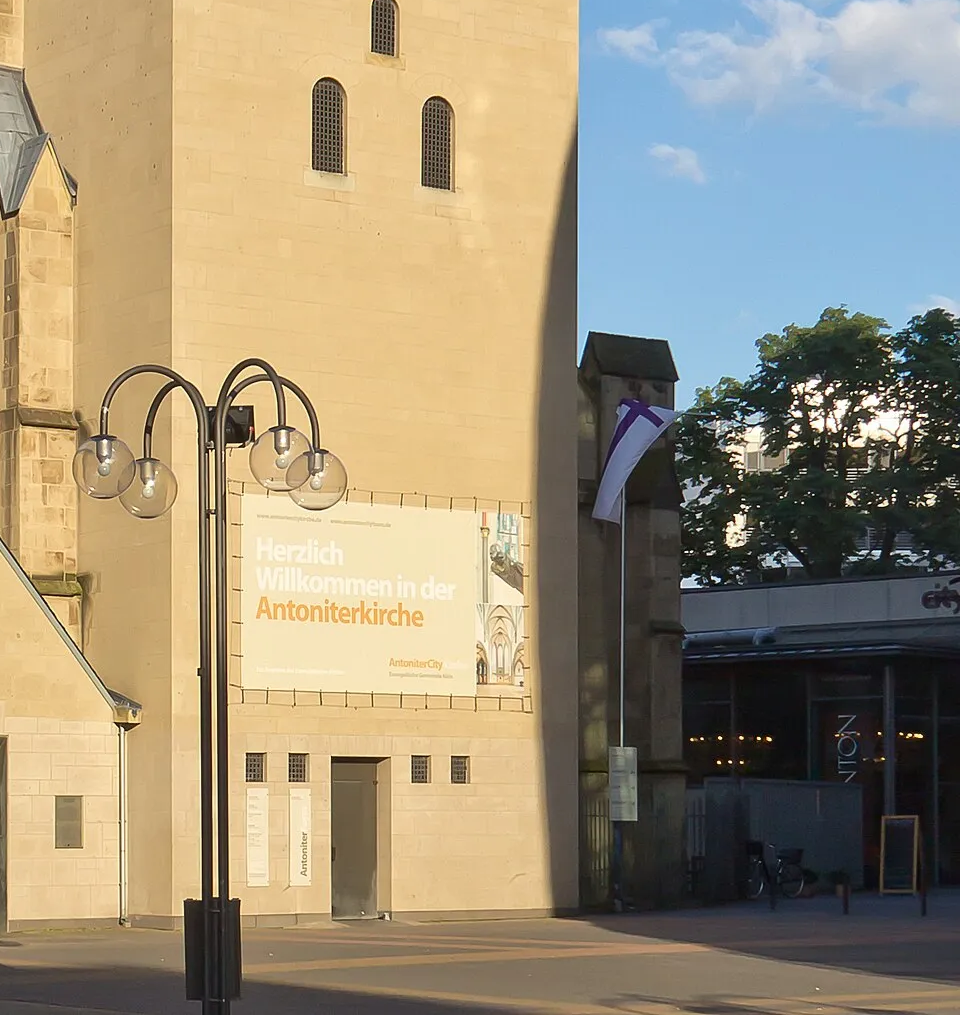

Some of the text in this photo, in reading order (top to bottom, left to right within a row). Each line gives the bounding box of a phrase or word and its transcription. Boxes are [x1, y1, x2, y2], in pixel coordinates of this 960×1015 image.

[256, 537, 344, 565] Herzlich
[256, 566, 456, 601] Willkommen in der
[256, 596, 424, 627] Antoniterkirche
[300, 831, 308, 876] Antoniter
